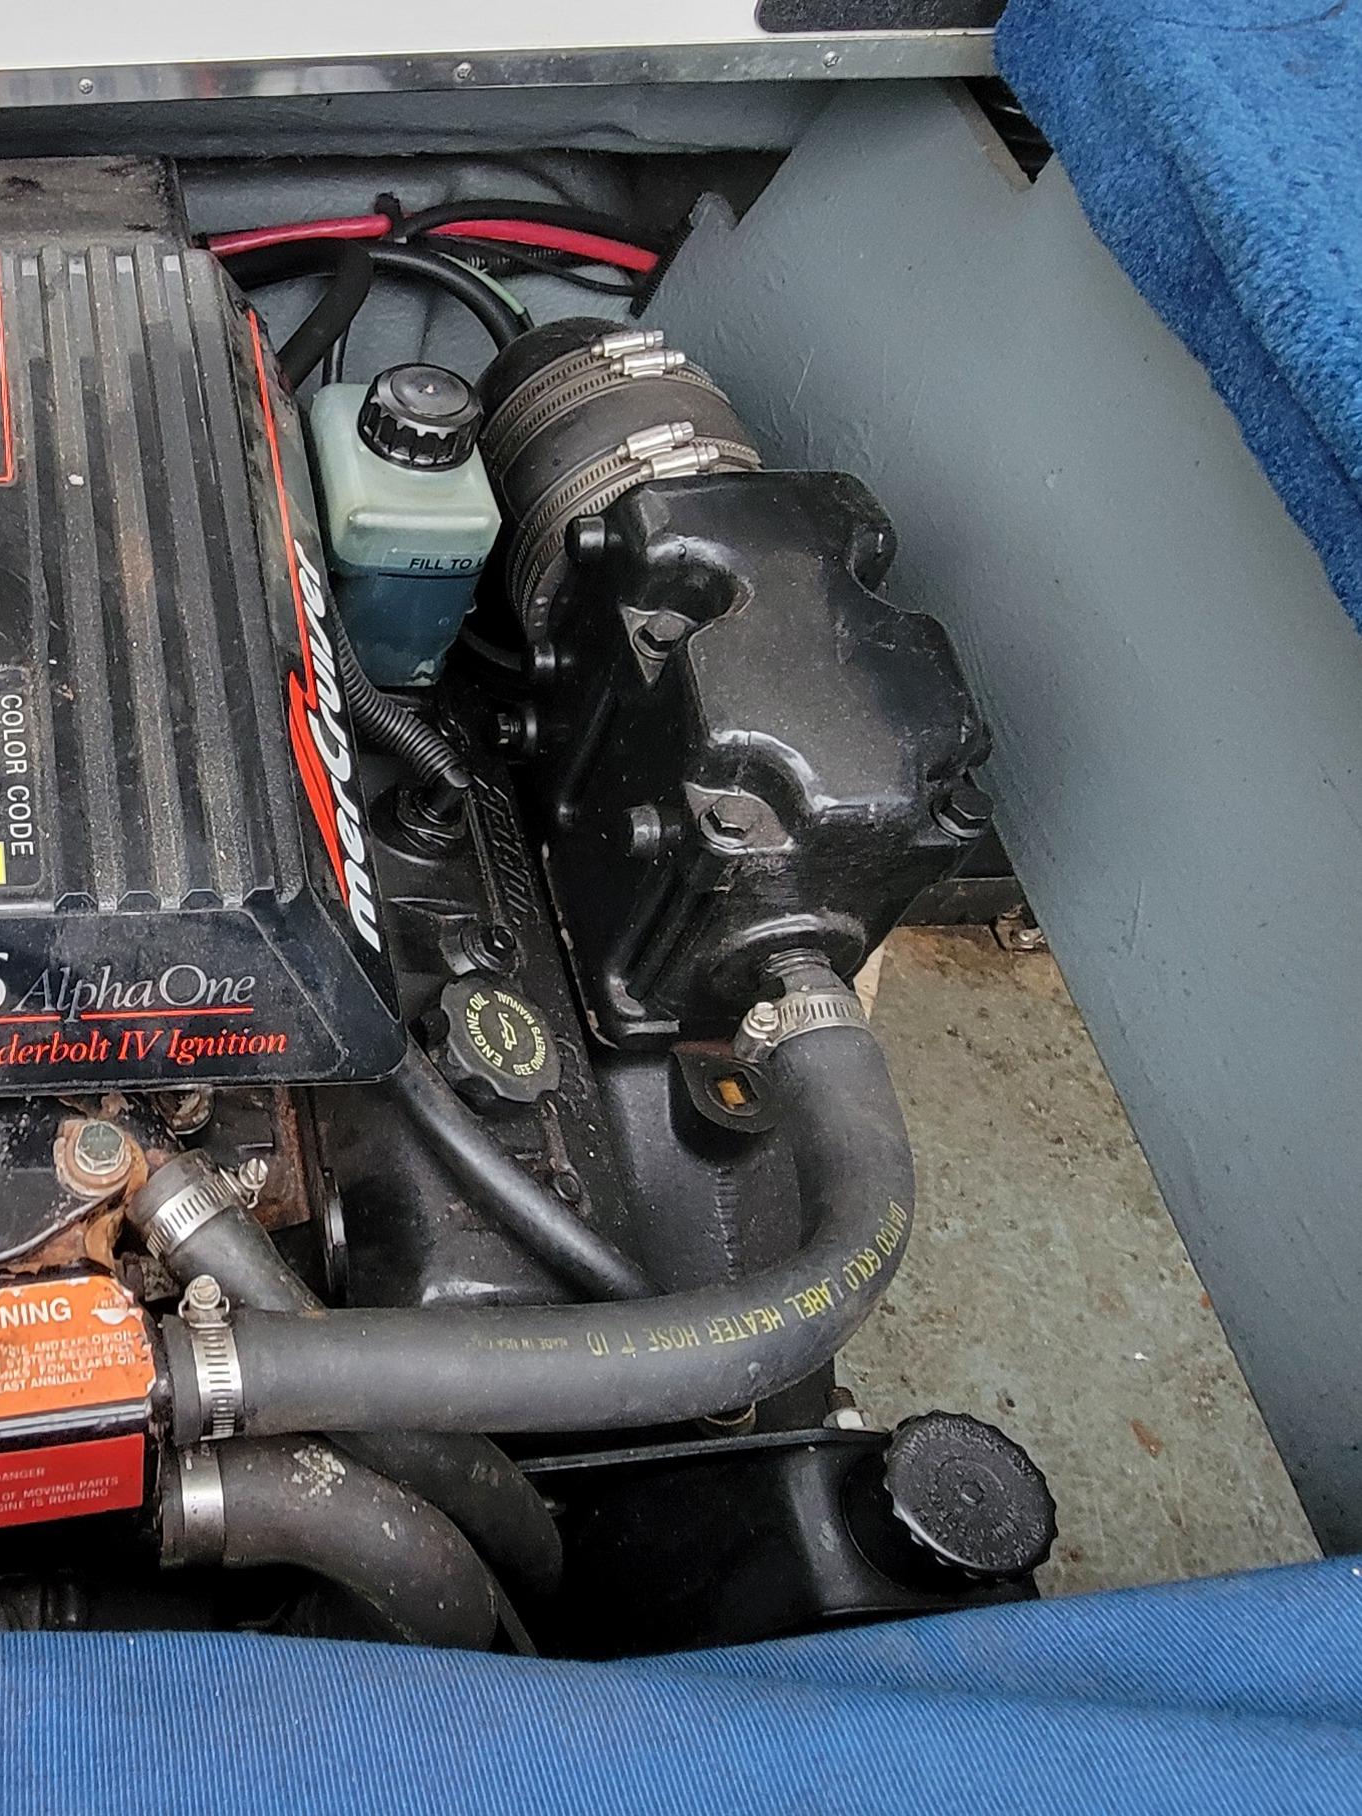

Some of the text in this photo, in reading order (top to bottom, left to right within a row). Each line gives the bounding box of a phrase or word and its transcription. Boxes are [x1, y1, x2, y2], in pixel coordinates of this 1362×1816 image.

[409, 558, 443, 570] FILL
[451, 558, 473, 570] TO
[1, 694, 34, 856] COLOR CODE
[493, 990, 536, 1026] MANUAL
[118, 1029, 165, 1062] IV
[166, 1027, 288, 1066] Ignition
[466, 991, 503, 1067] ENGINE OIL
[512, 1063, 534, 1076] SEE
[875, 1200, 907, 1256] DAYCO
[842, 1247, 882, 1291] GOLD
[784, 1277, 844, 1321] LABEL
[648, 1324, 701, 1352] HOSE
[708, 1304, 786, 1345] HEATER
[34, 1340, 59, 1352] AND
[31, 1369, 94, 1389] ANNUALLY
[1, 1491, 17, 1502] OF
[23, 1482, 75, 1499] MOVING
[79, 1476, 119, 1490] PARTS
[31, 1498, 45, 1508] IS
[48, 1488, 110, 1505] RUNNING
